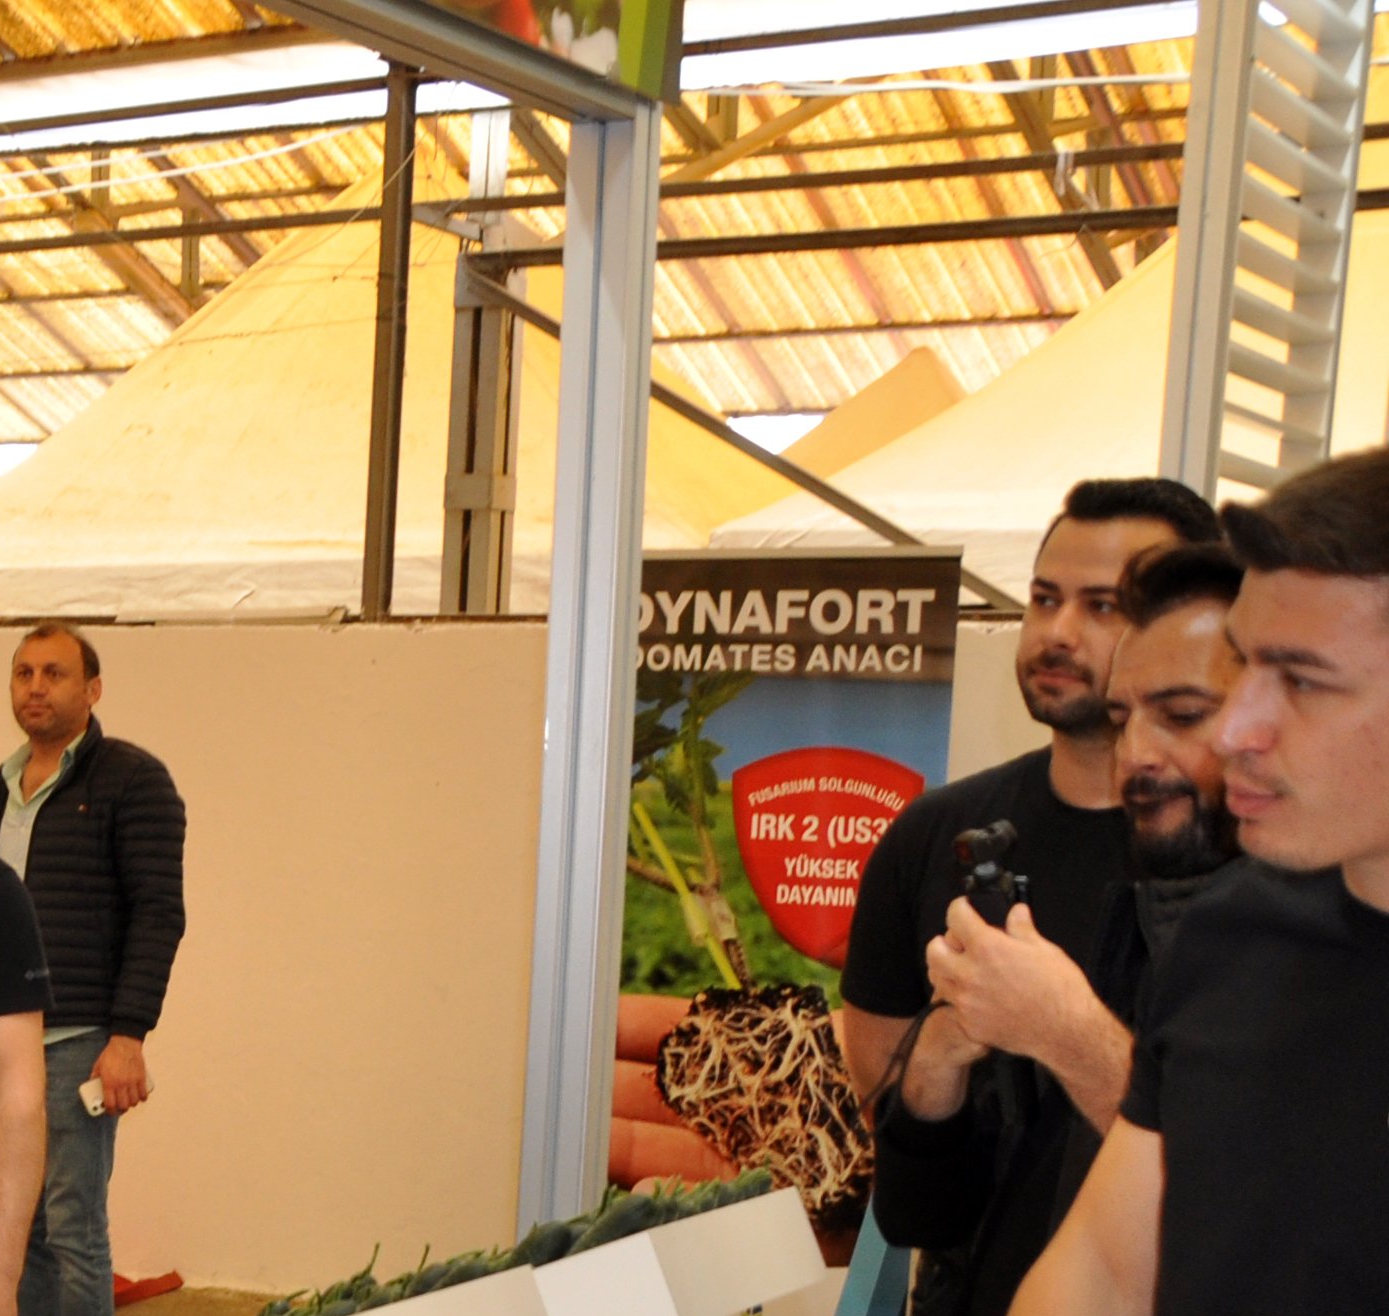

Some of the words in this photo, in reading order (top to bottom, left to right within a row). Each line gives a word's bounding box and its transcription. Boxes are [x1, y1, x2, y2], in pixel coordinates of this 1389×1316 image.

[805, 643, 923, 673] ANACI
[748, 778, 816, 807] FUSARIUM
[819, 777, 905, 812] SOLGUNLUĞU
[750, 813, 796, 841] IRK
[801, 815, 820, 842] 2
[827, 815, 894, 848] (US3
[784, 854, 860, 880] YÜKSEK
